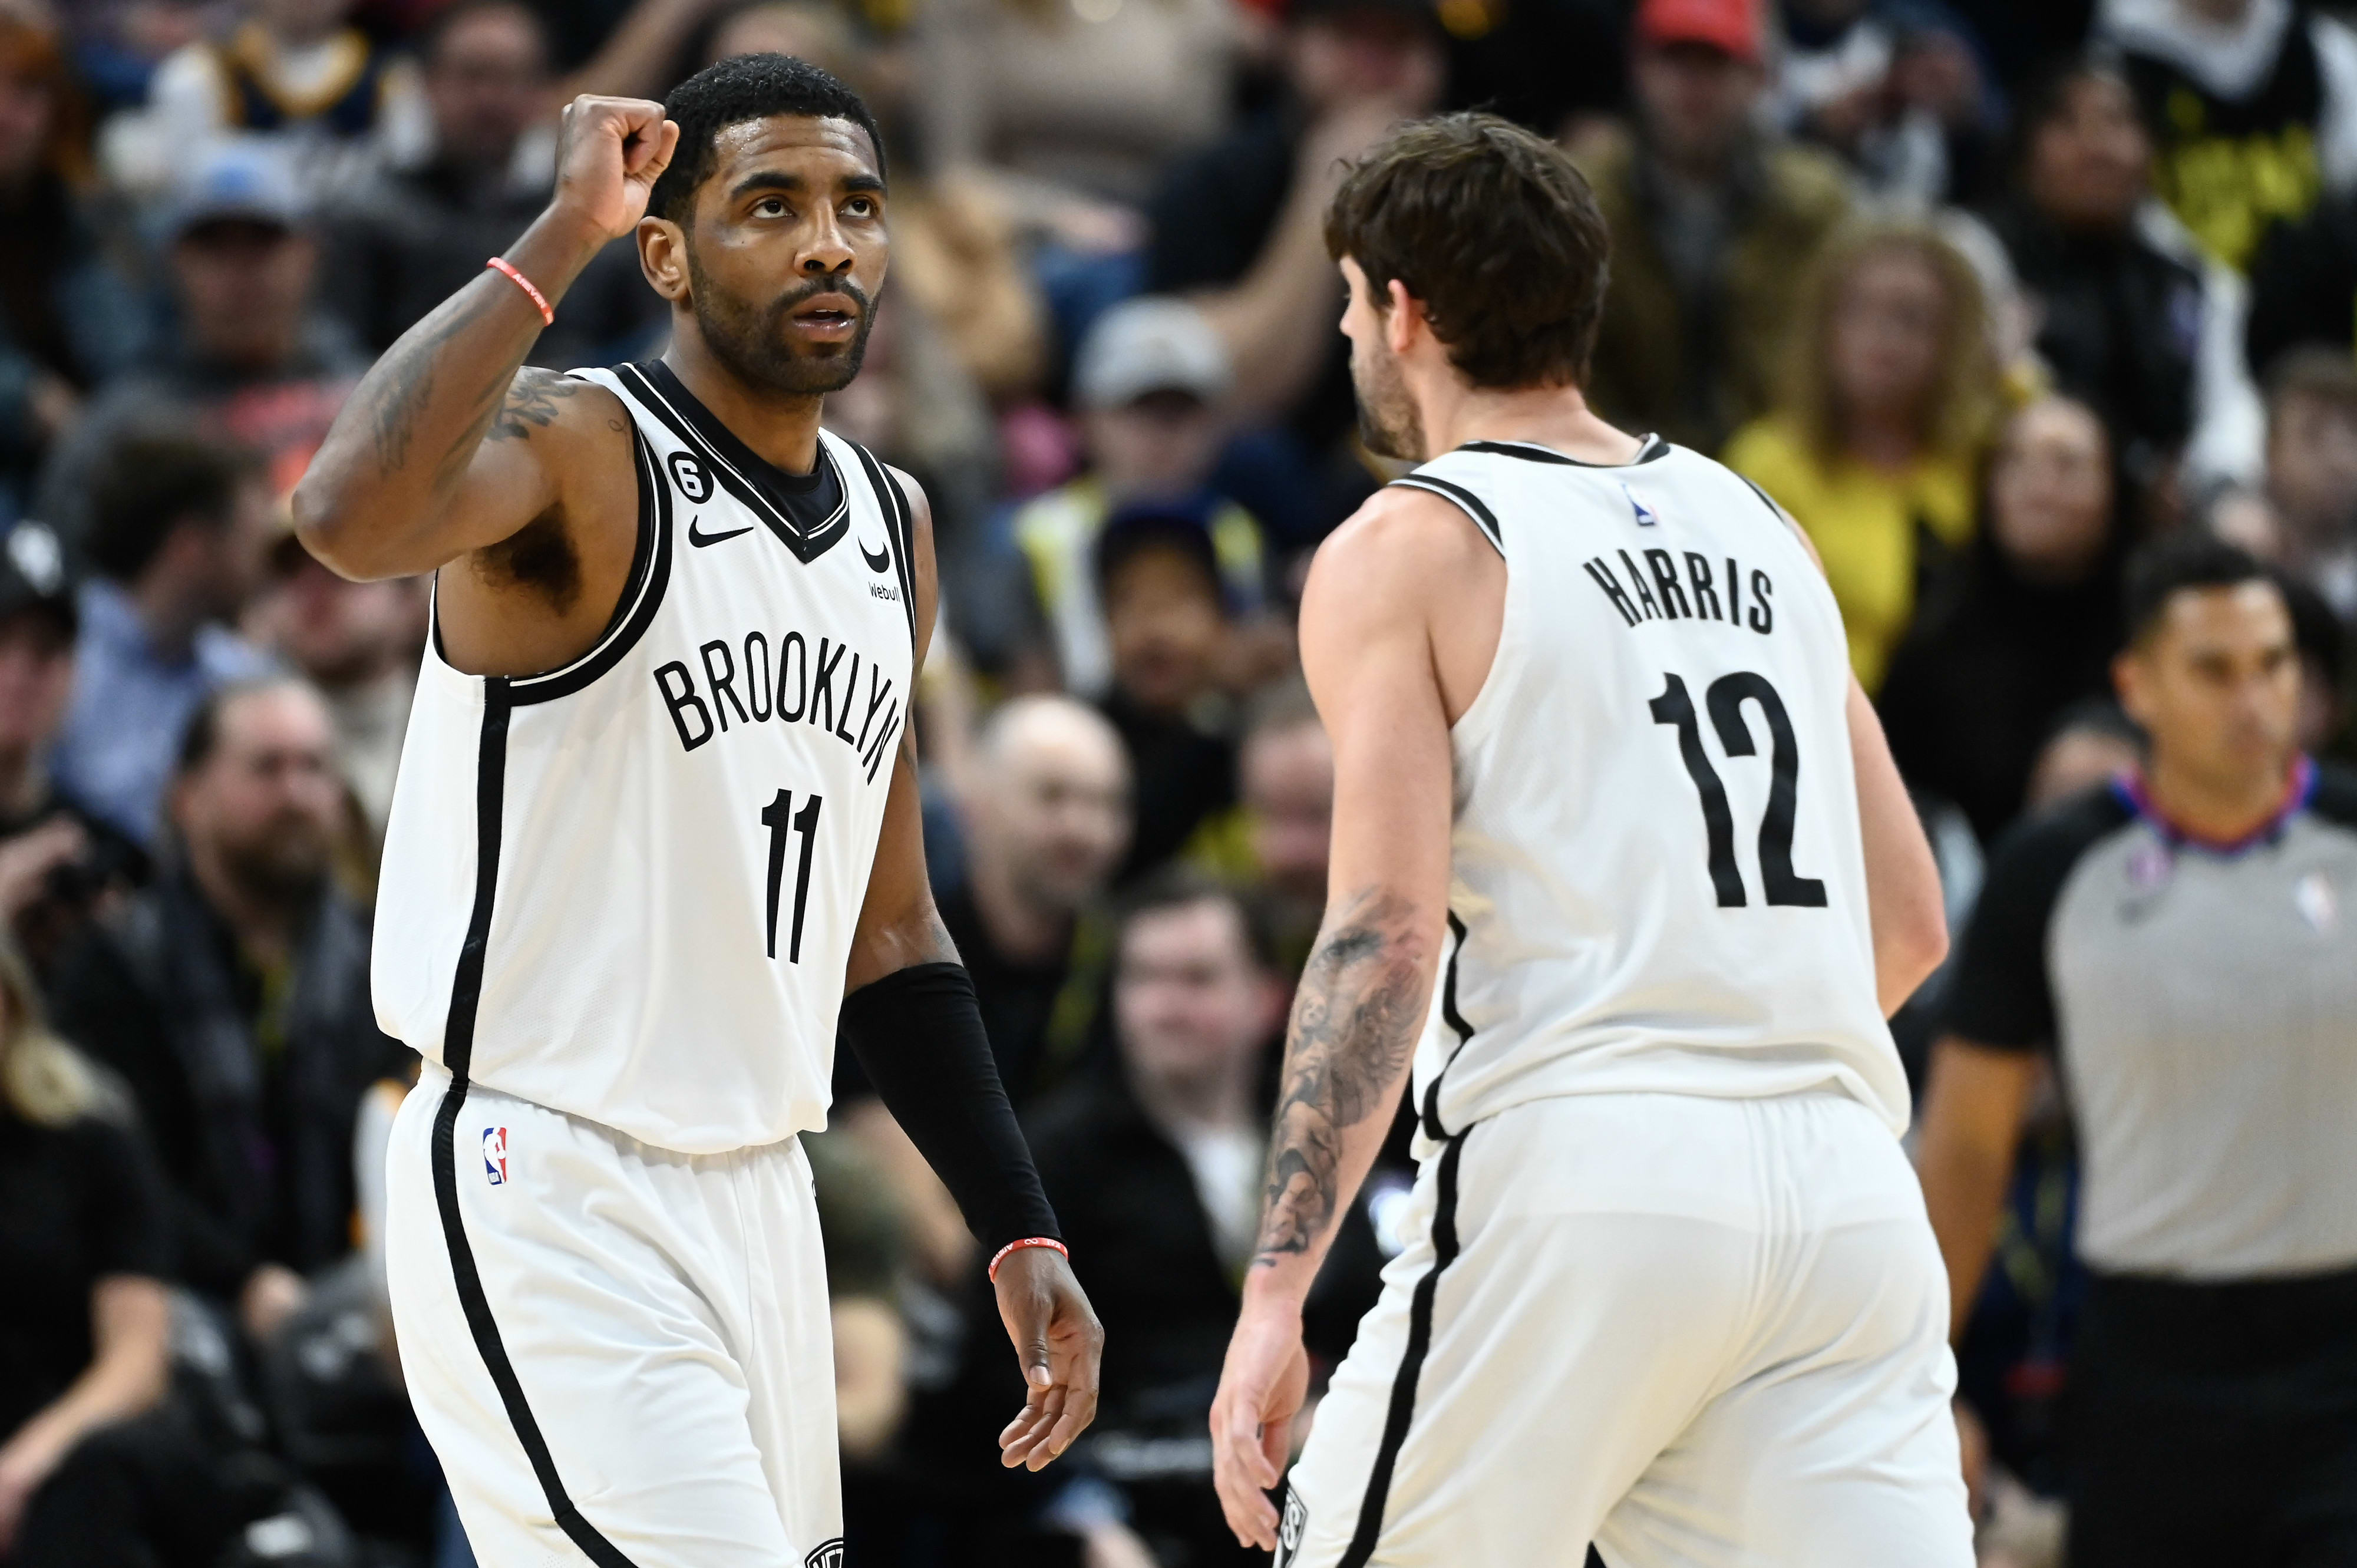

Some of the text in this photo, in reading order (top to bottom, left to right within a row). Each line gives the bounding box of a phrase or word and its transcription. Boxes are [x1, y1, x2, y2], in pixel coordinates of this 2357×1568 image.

[675, 460, 704, 497] 6
[868, 580, 900, 602] Webull
[1583, 549, 1772, 635] HARRIS
[653, 631, 900, 786] BROOKLYN
[1648, 671, 1828, 908] 12
[761, 788, 823, 965] 11
